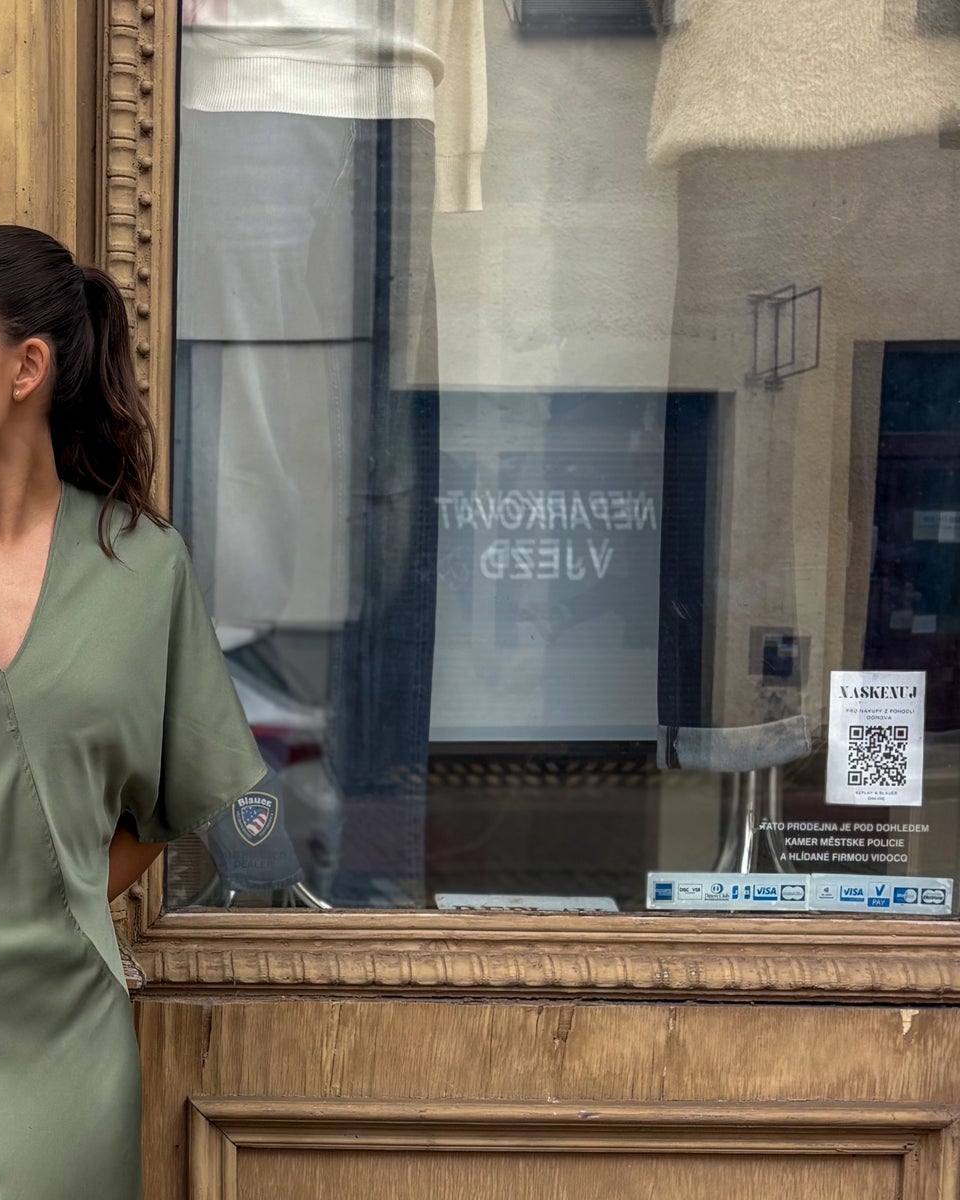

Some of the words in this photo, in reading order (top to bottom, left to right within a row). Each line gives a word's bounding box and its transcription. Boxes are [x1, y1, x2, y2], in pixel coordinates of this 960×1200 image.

[839, 686, 917, 699] NASKENUJ
[761, 822, 785, 831] TATO
[787, 822, 838, 831] PRODEJNA
[839, 823, 852, 832] JE
[853, 823, 874, 832] POD
[876, 823, 930, 833] DOHLEDEM
[785, 837, 818, 846] KAMER
[867, 838, 905, 847] POLICIE
[780, 852, 787, 861] A
[832, 853, 869, 862] FIRMOU
[757, 886, 777, 896] VISA
[844, 887, 864, 897] VISA
